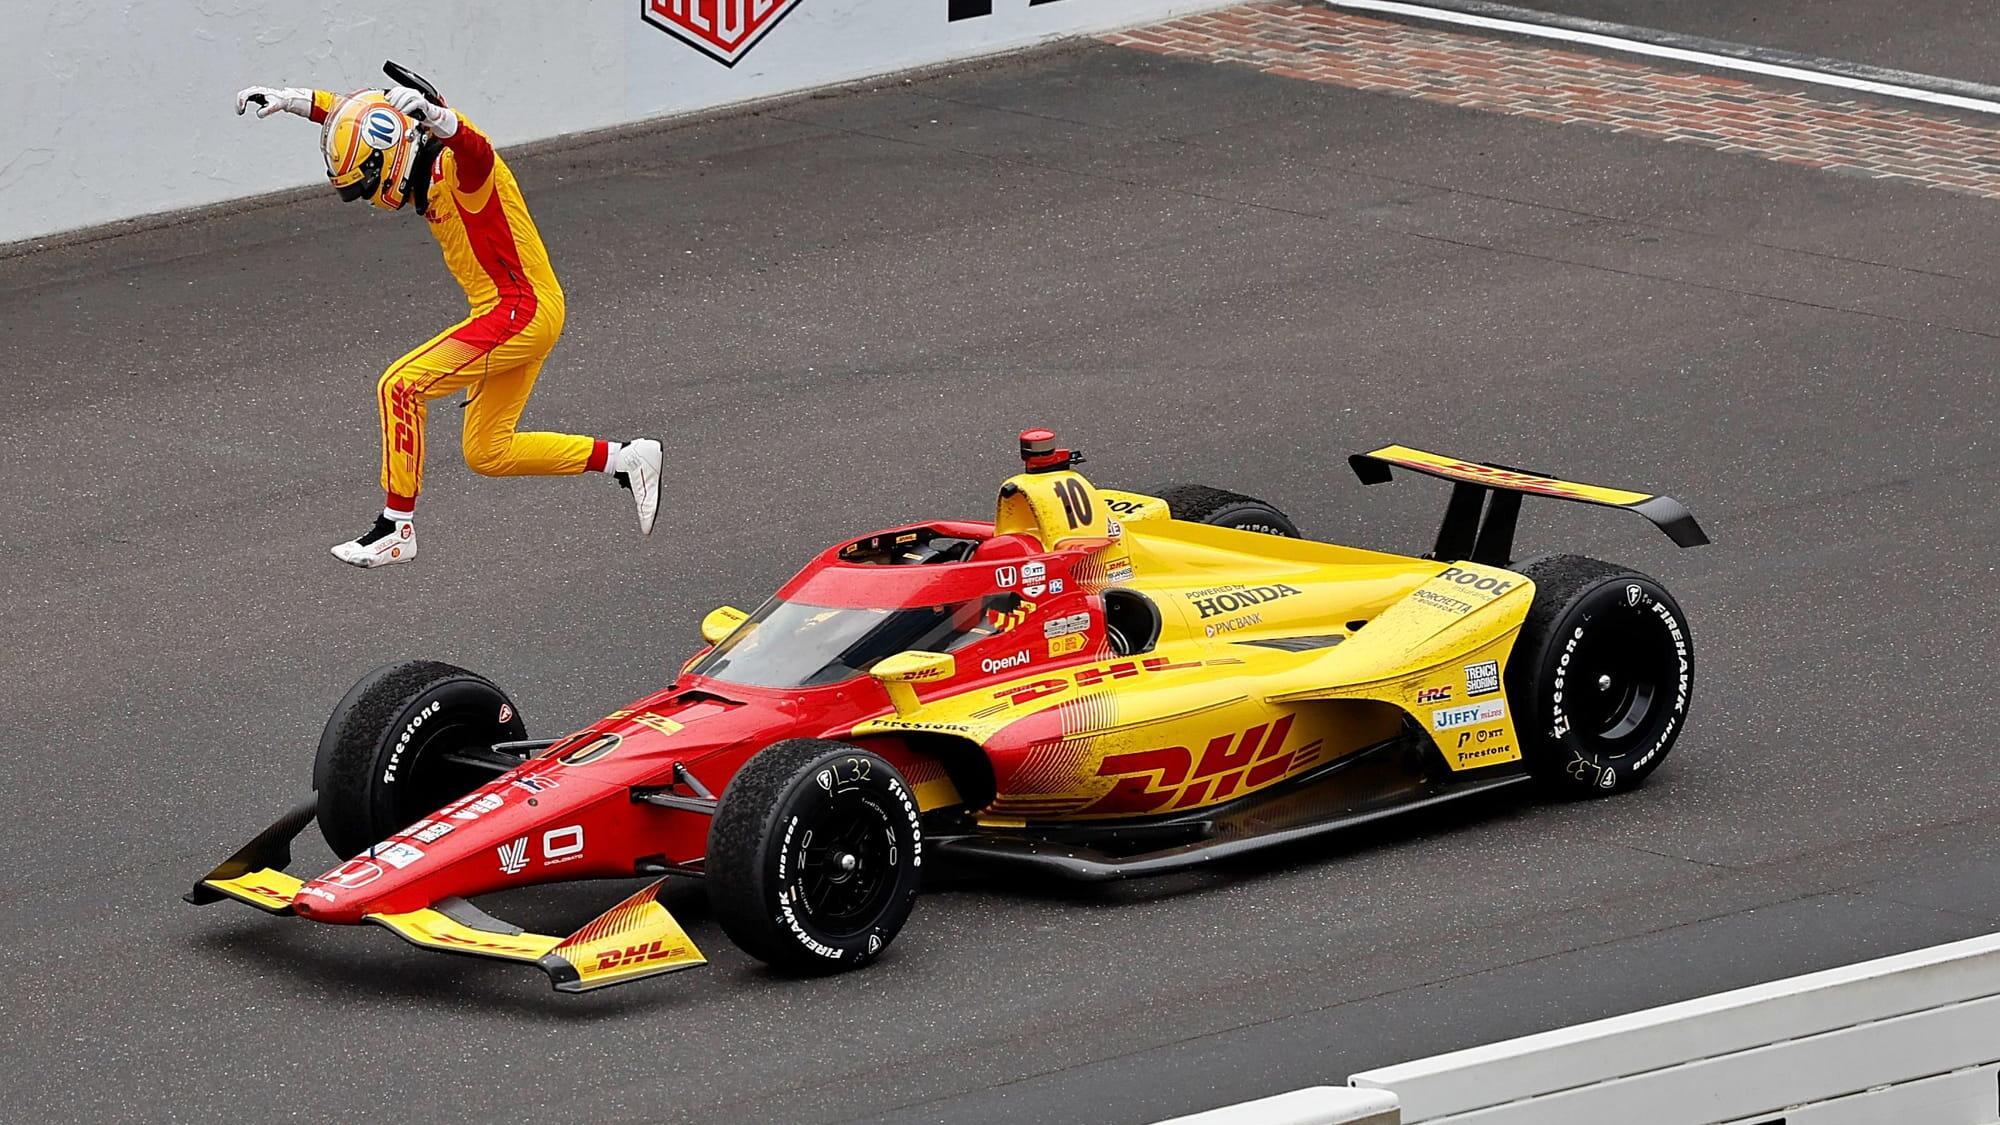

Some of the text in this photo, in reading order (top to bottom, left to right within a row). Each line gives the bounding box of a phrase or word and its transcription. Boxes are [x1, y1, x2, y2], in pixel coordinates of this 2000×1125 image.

[368, 112, 396, 144] 10
[1053, 477, 1093, 530] 10
[1185, 585, 1232, 600] POWERED
[1435, 567, 1512, 596] Root
[1192, 583, 1302, 619] HONDA
[1413, 589, 1472, 614] BORCHETTA
[981, 649, 1031, 675] OpenAI
[1464, 663, 1497, 679] TRENCH
[1651, 602, 1689, 714] FIREHAWK
[903, 667, 939, 680] DHL
[1466, 676, 1498, 692] SHORING
[1553, 627, 1584, 739] Firestone
[1417, 685, 1452, 703] HRC
[871, 719, 970, 732] Firestone
[1437, 709, 1479, 727] JIFFY
[384, 701, 441, 784] Firestone
[1488, 729, 1504, 739] NTT
[1080, 713, 1297, 815] DHL
[1458, 744, 1511, 762] Firestone
[888, 777, 922, 868] Firestone
[779, 891, 844, 959] FIREHAWK
[595, 940, 671, 971] DHL
